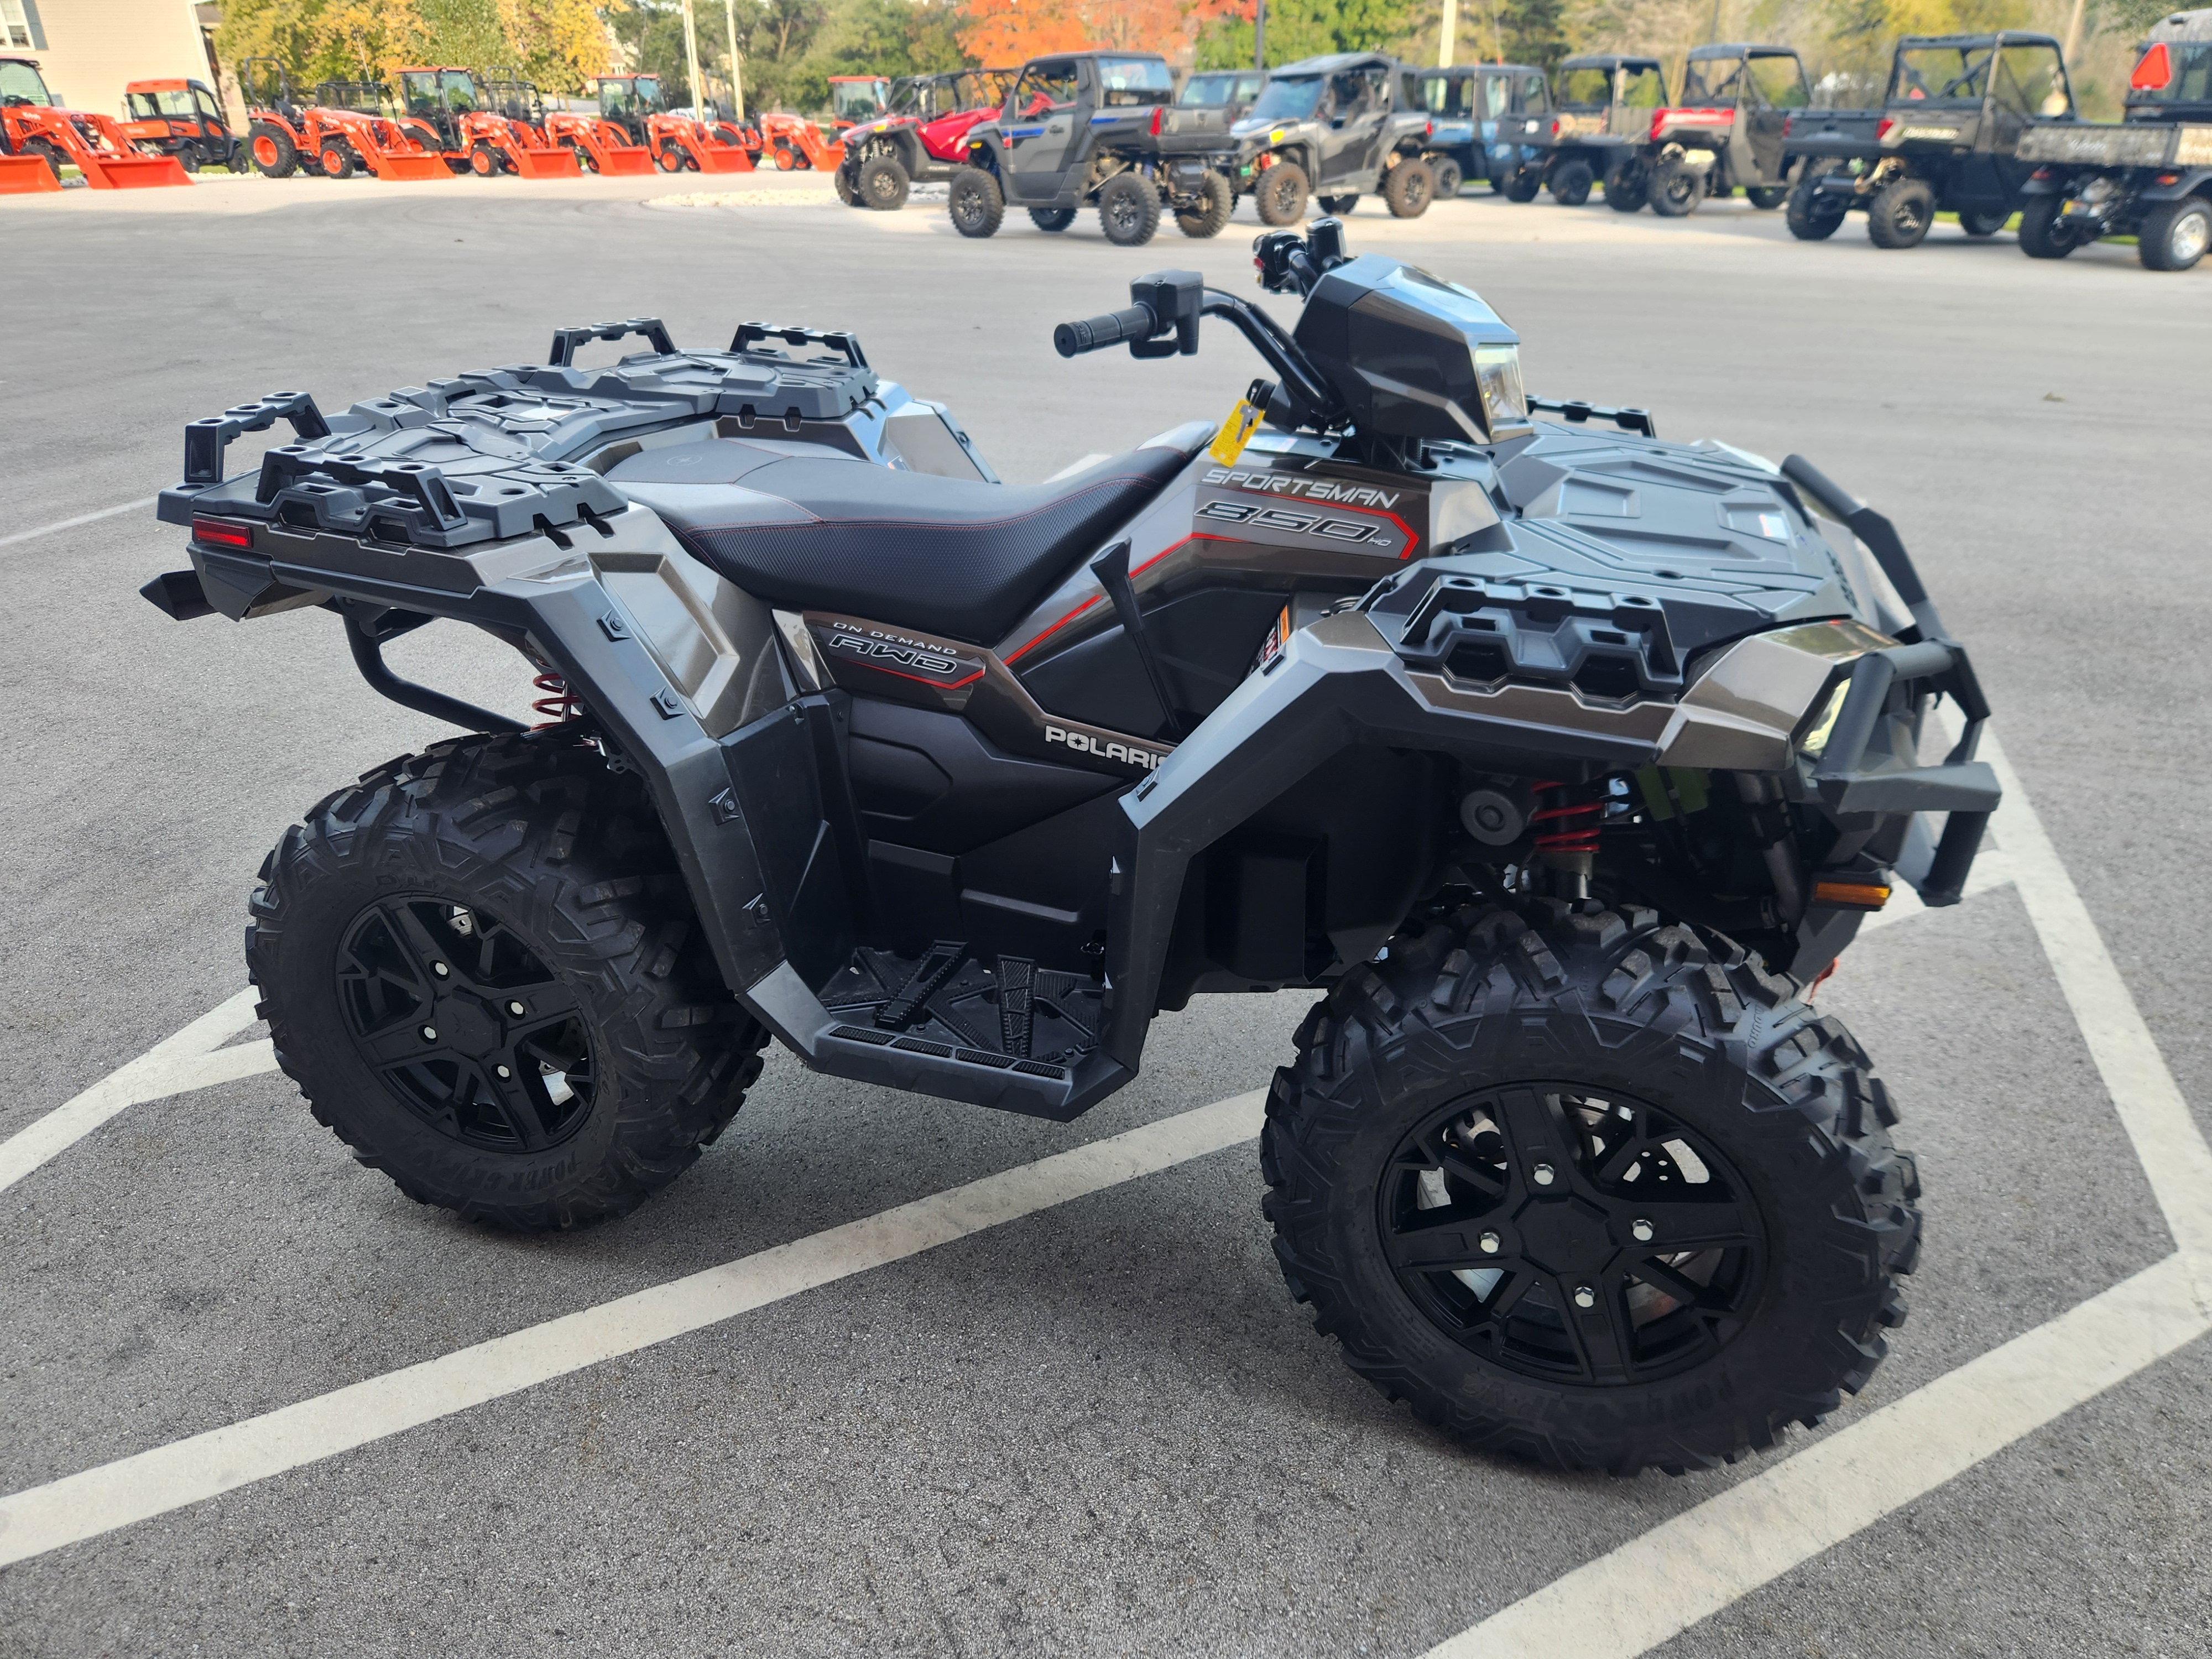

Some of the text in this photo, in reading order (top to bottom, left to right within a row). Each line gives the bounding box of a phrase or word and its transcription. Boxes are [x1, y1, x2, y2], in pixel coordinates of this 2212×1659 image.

[1201, 469, 1400, 509] SPORTSMAN
[1194, 500, 1392, 547] 850 HD
[829, 634, 958, 674] AWD
[833, 622, 958, 656] ON DEMAND
